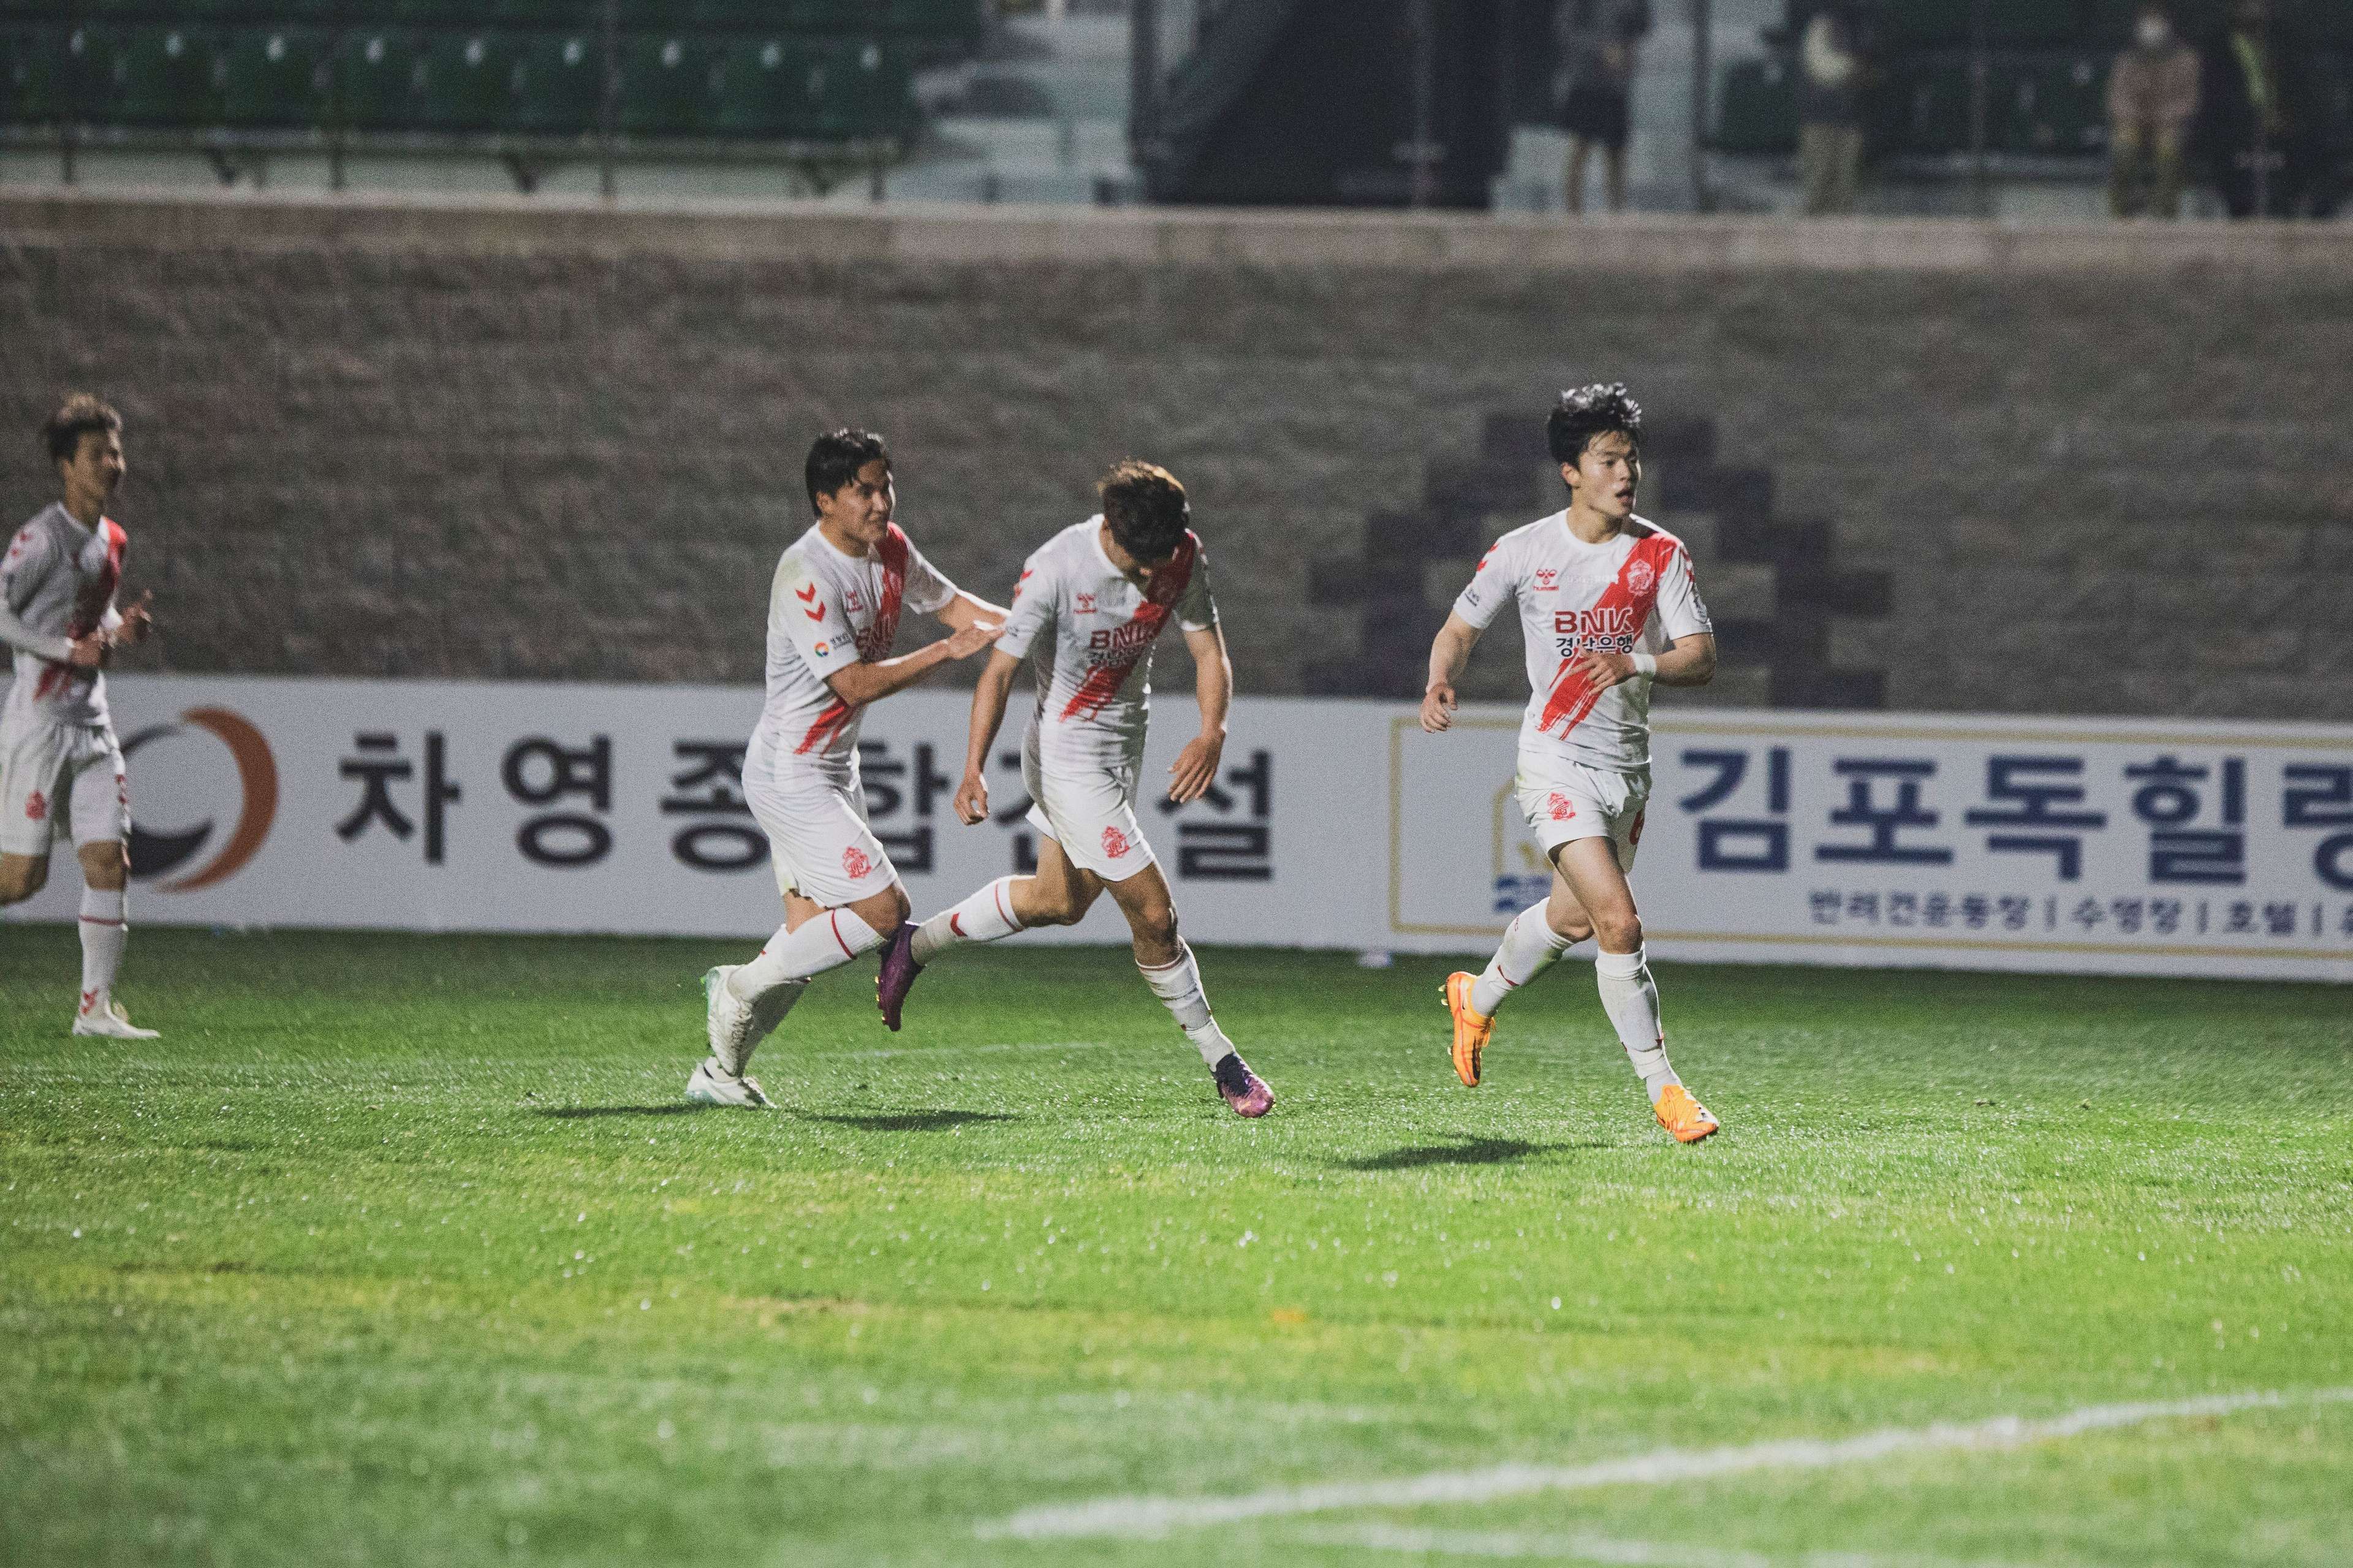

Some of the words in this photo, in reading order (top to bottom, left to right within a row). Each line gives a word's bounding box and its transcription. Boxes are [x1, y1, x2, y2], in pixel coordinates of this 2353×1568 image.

[1555, 607, 1634, 634] BNK
[2073, 896, 2181, 934] 수영장
[2224, 901, 2295, 936] 호텔
